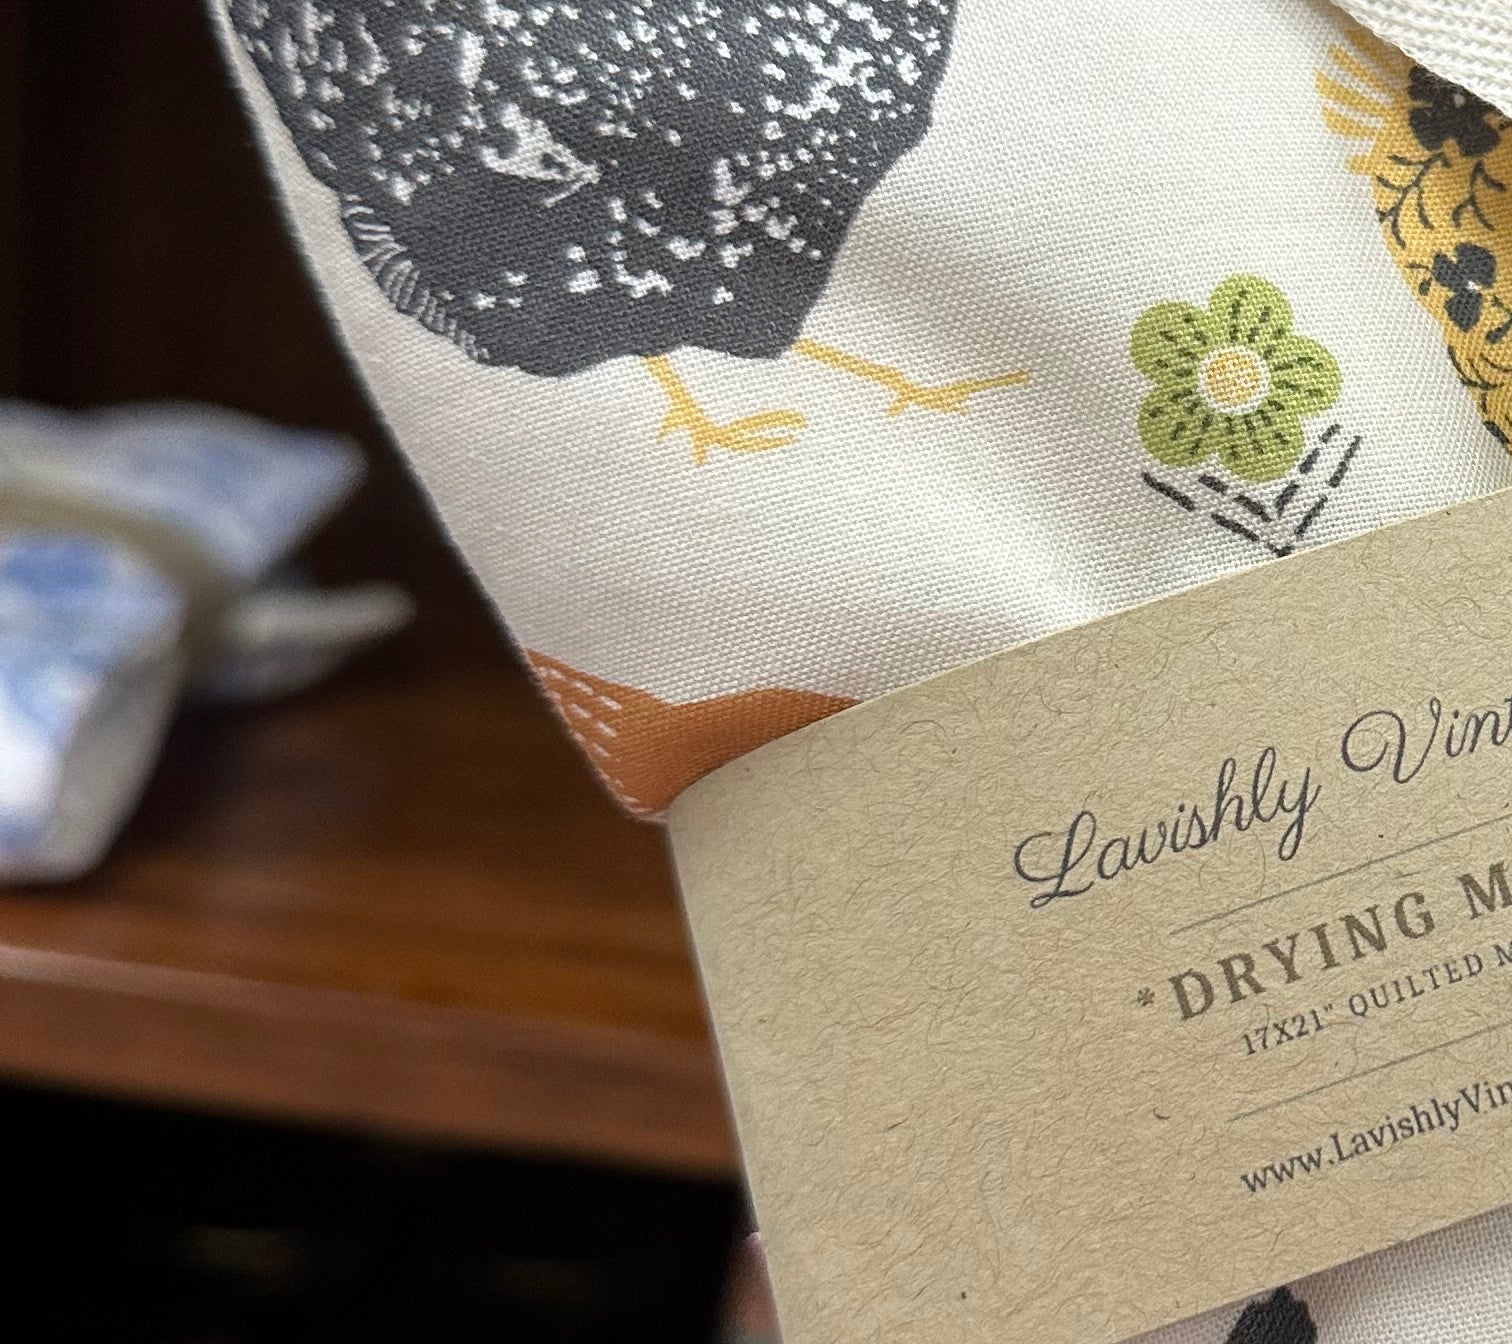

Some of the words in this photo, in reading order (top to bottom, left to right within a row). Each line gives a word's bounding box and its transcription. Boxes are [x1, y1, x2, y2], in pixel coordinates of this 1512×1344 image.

[1014, 747, 1321, 909] Lavishly
[1241, 1003, 1333, 1055] 17X21"
[1349, 953, 1484, 1017] QUILTED
